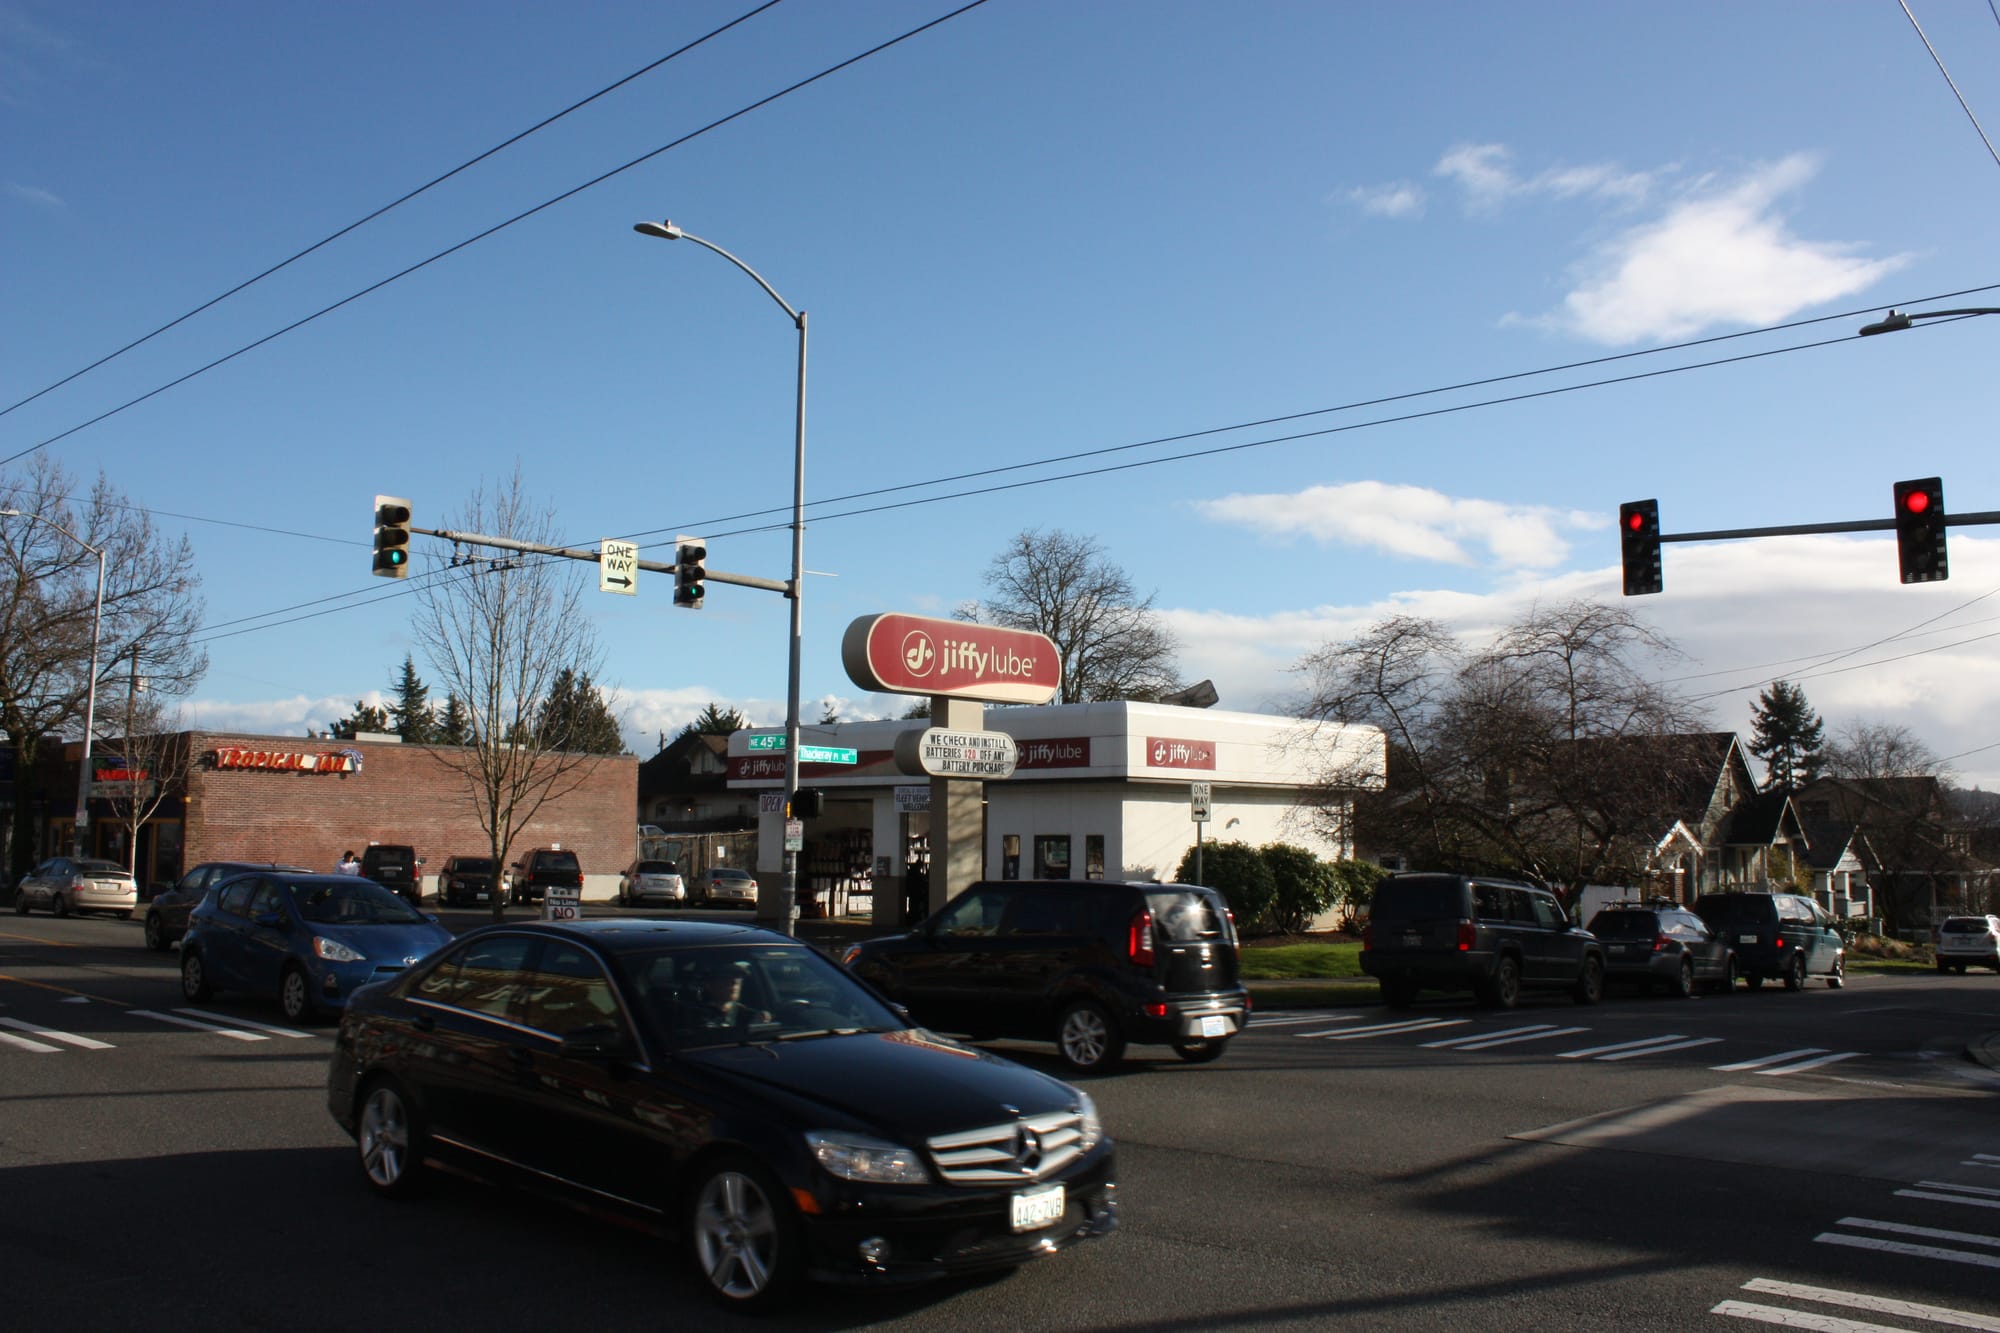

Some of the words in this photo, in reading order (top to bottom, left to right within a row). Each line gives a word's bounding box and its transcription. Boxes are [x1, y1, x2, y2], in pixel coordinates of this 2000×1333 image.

[607, 544, 632, 559] ONE
[607, 558, 632, 572] WAY
[940, 640, 988, 679] jiffy
[750, 738, 759, 747] NE
[930, 734, 942, 745] WE
[943, 735, 967, 747] CHECK
[968, 737, 981, 748] AND
[981, 738, 1007, 749] INSTALL
[216, 746, 305, 769] TROPICAL
[313, 751, 346, 773] TAN
[800, 747, 833, 762] Thackeray
[841, 752, 850, 762] NE
[926, 746, 961, 759] BATTERIES
[980, 750, 992, 760] OFF
[993, 751, 1005, 762] ANY
[1027, 744, 1055, 764] jiffy
[1056, 744, 1082, 759] lube
[1169, 744, 1190, 764] jiffy
[752, 759, 771, 776] jiffy
[942, 760, 971, 772] BATTERY
[972, 762, 1005, 774] PURCHASE
[1194, 784, 1208, 795] ONE
[1194, 795, 1208, 806] WAY
